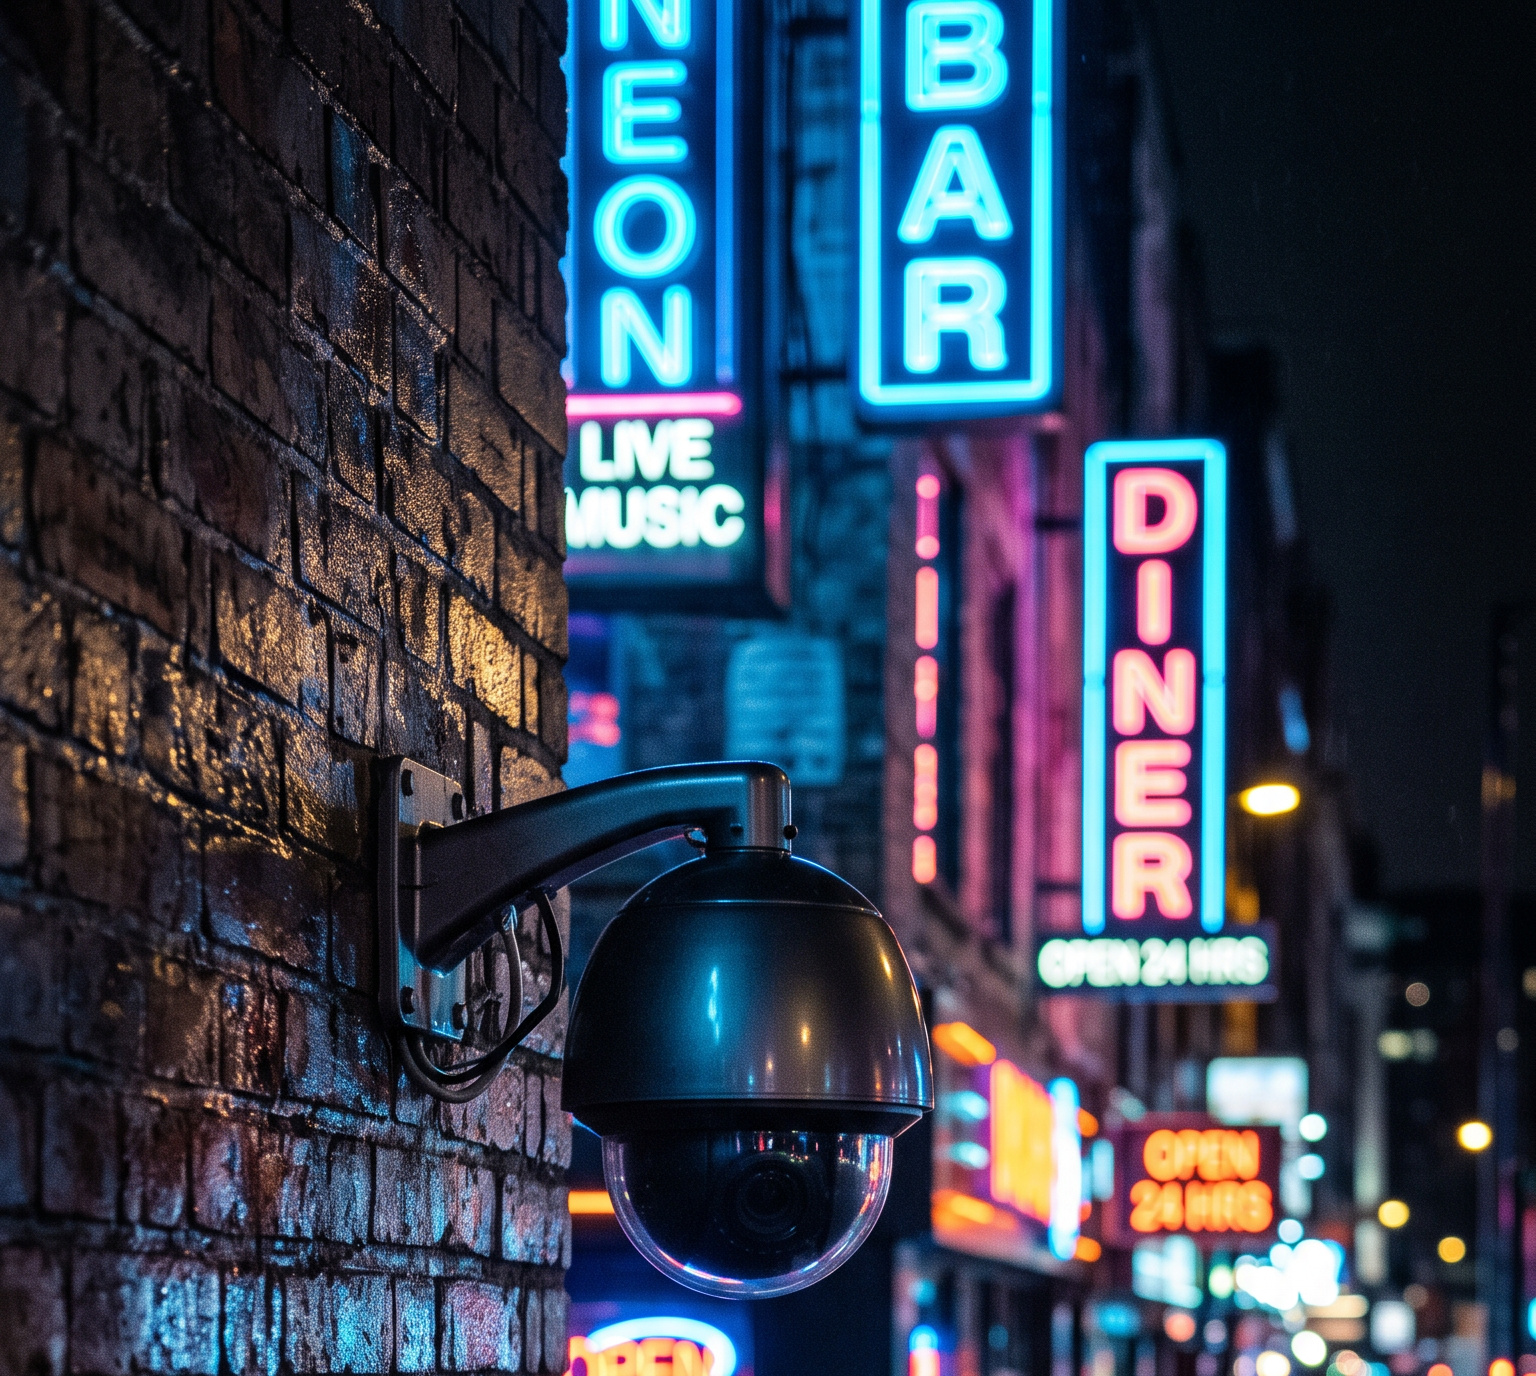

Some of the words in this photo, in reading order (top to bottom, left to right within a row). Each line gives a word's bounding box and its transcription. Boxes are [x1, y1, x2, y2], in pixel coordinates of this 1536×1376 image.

[897, 0, 1013, 374] BAR
[579, 418, 715, 482] LIVE
[564, 483, 746, 549] MUSIC
[1112, 467, 1198, 920] DINER
[1038, 938, 1140, 988] OPEN
[1140, 937, 1187, 987] 24
[1143, 1129, 1260, 1181] OPEN
[1129, 1179, 1184, 1233] 24
